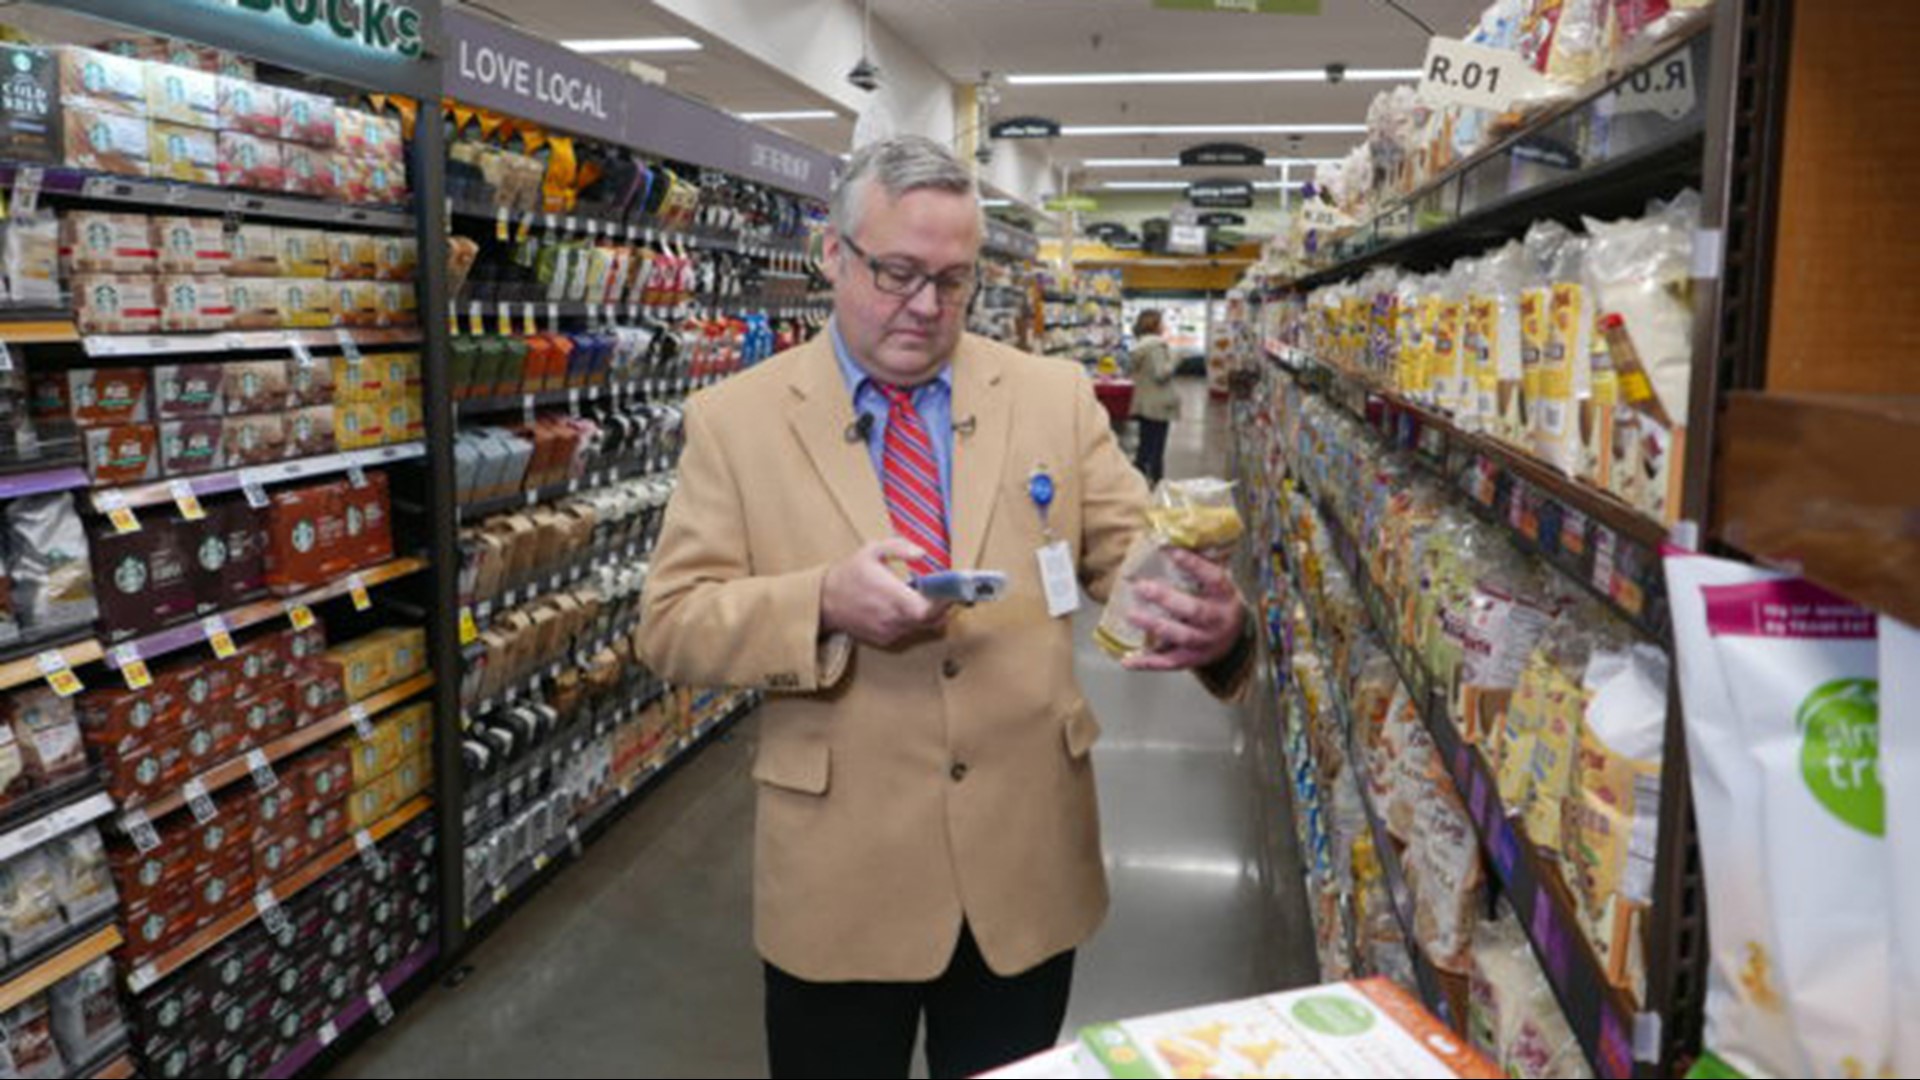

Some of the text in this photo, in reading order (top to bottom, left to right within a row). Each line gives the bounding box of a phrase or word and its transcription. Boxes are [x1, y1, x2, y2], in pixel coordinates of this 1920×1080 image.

[236, 0, 421, 57] UCKS
[459, 40, 608, 120] LOVE LOCAL
[1428, 53, 1500, 95] R.01
